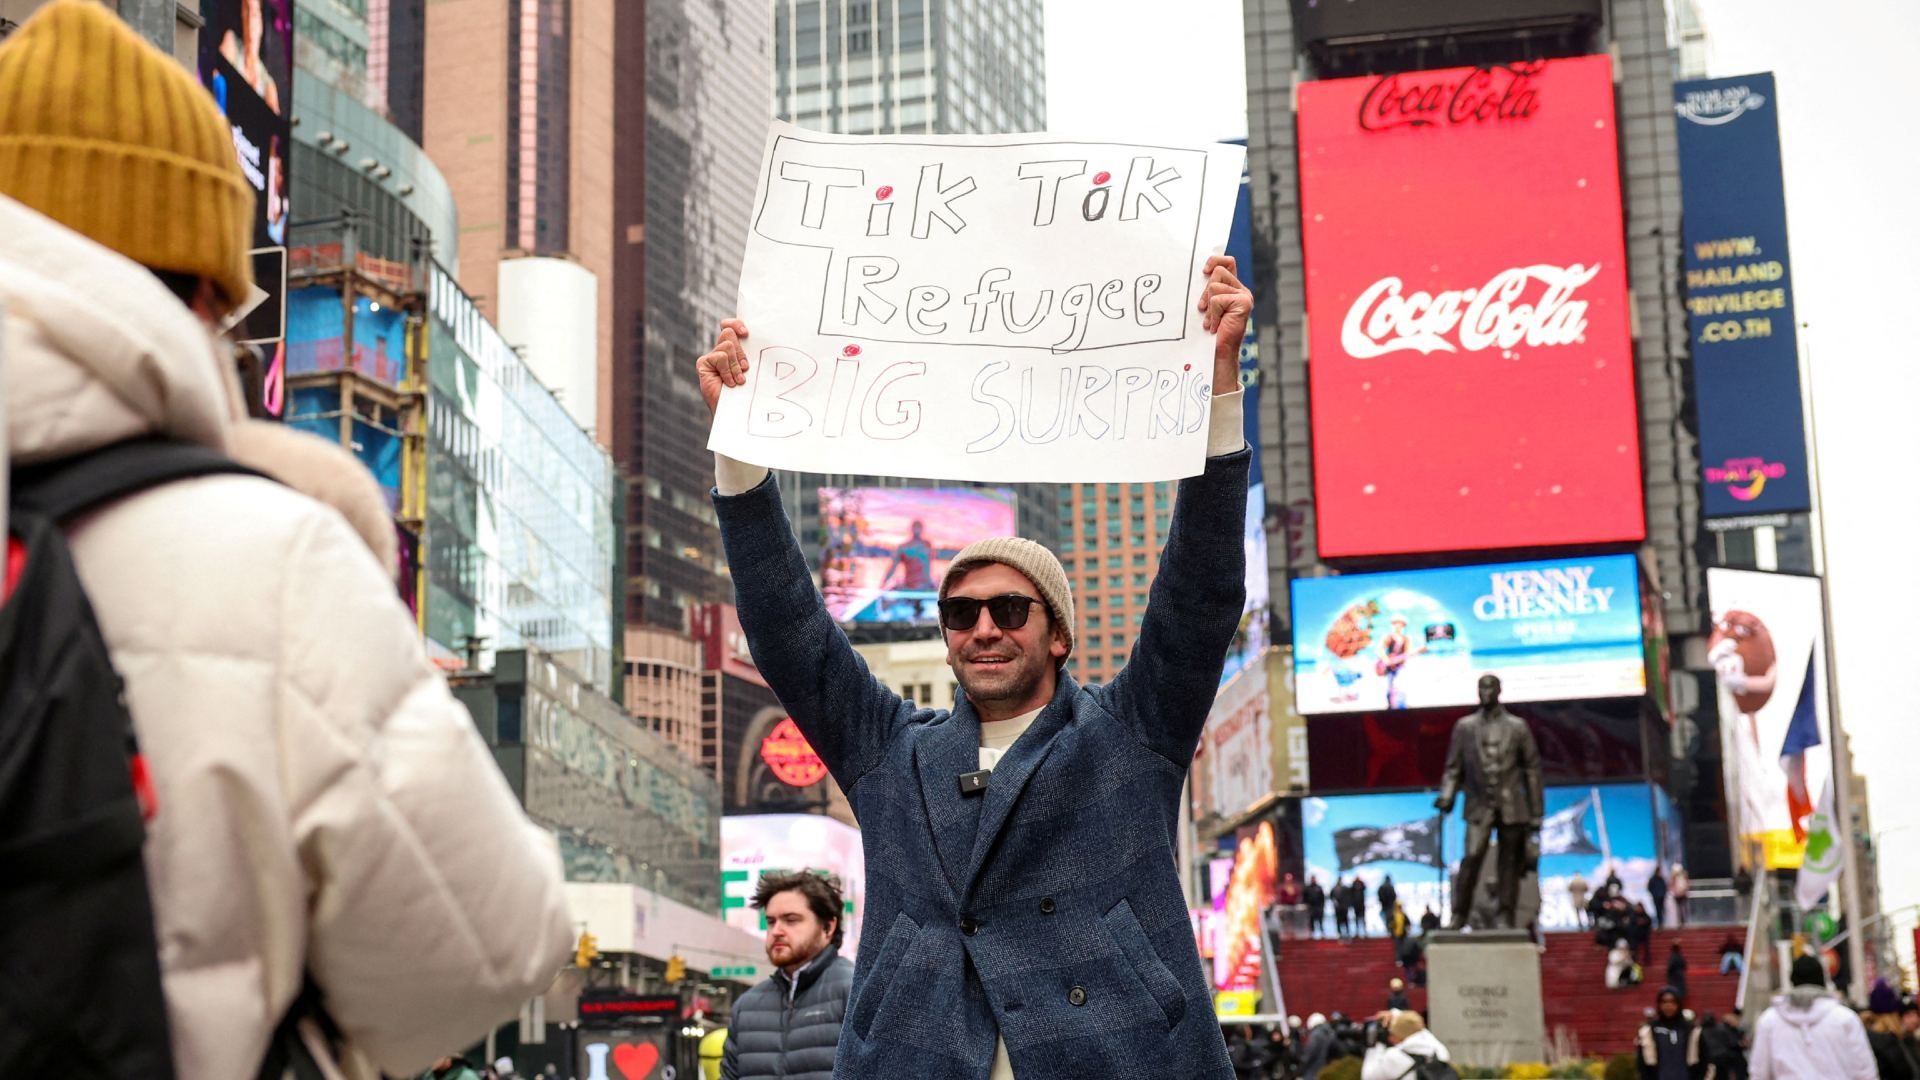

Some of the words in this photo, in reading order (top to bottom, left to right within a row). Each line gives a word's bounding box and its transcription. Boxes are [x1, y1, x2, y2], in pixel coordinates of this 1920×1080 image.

[1359, 62, 1548, 133] Coca-Cola
[1686, 261, 1784, 289] HAILAND
[842, 256, 1165, 354] Refugee
[1341, 263, 1600, 359] Coca-Cola
[1473, 587, 1615, 621] CHESNEY
[1490, 566, 1594, 599] KENNY
